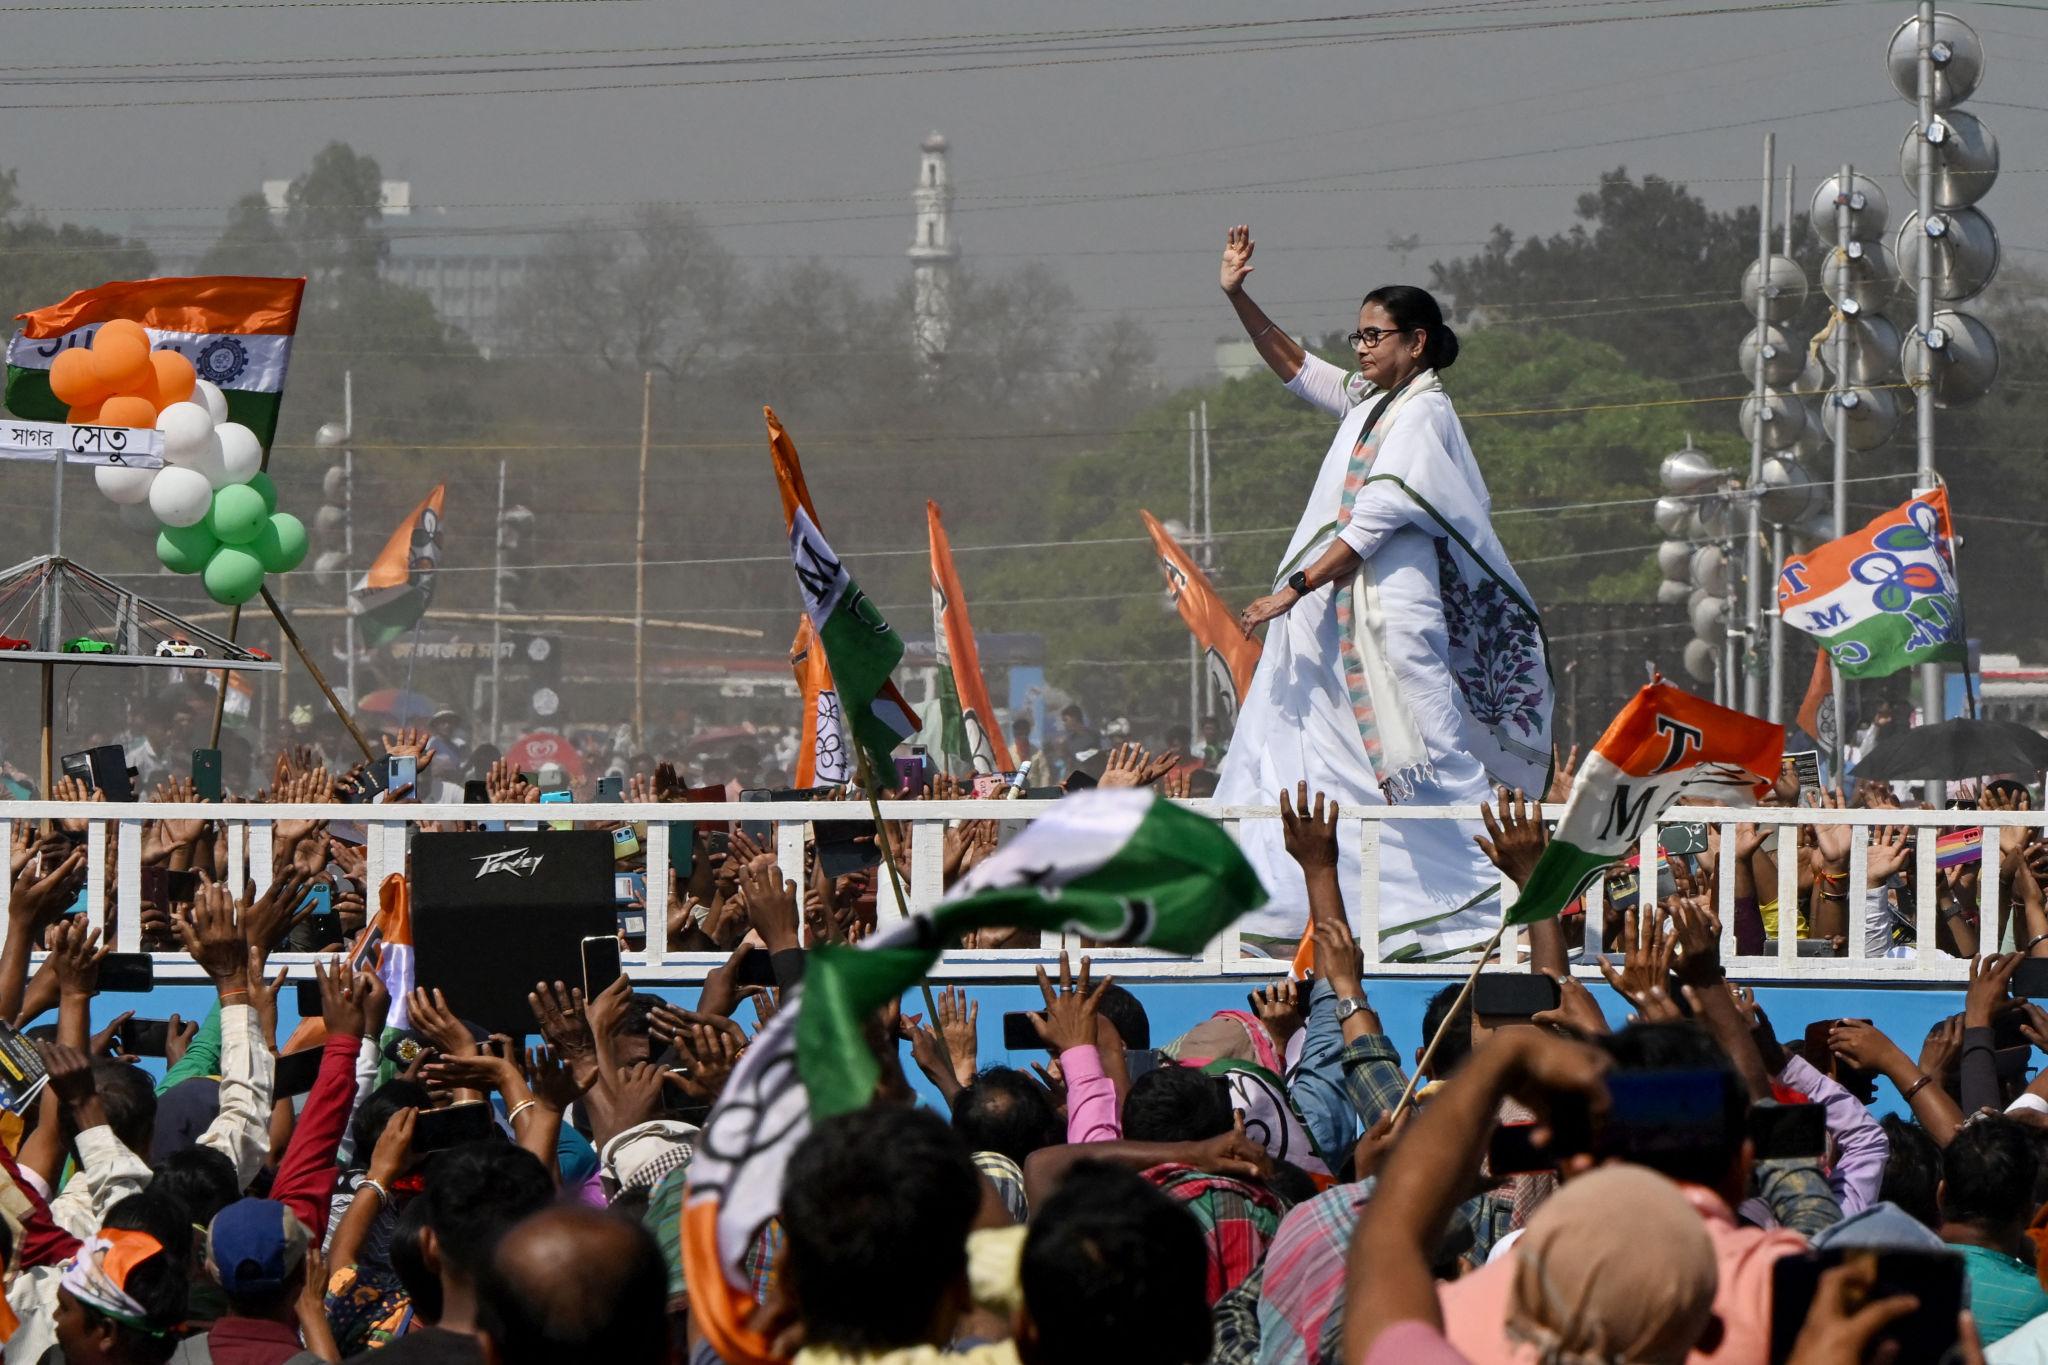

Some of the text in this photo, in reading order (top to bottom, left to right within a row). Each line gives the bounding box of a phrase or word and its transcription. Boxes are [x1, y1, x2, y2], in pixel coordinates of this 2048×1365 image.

[11, 425, 130, 466] সাগর সেতু
[1650, 714, 1703, 777] T
[1597, 783, 1660, 843] M
